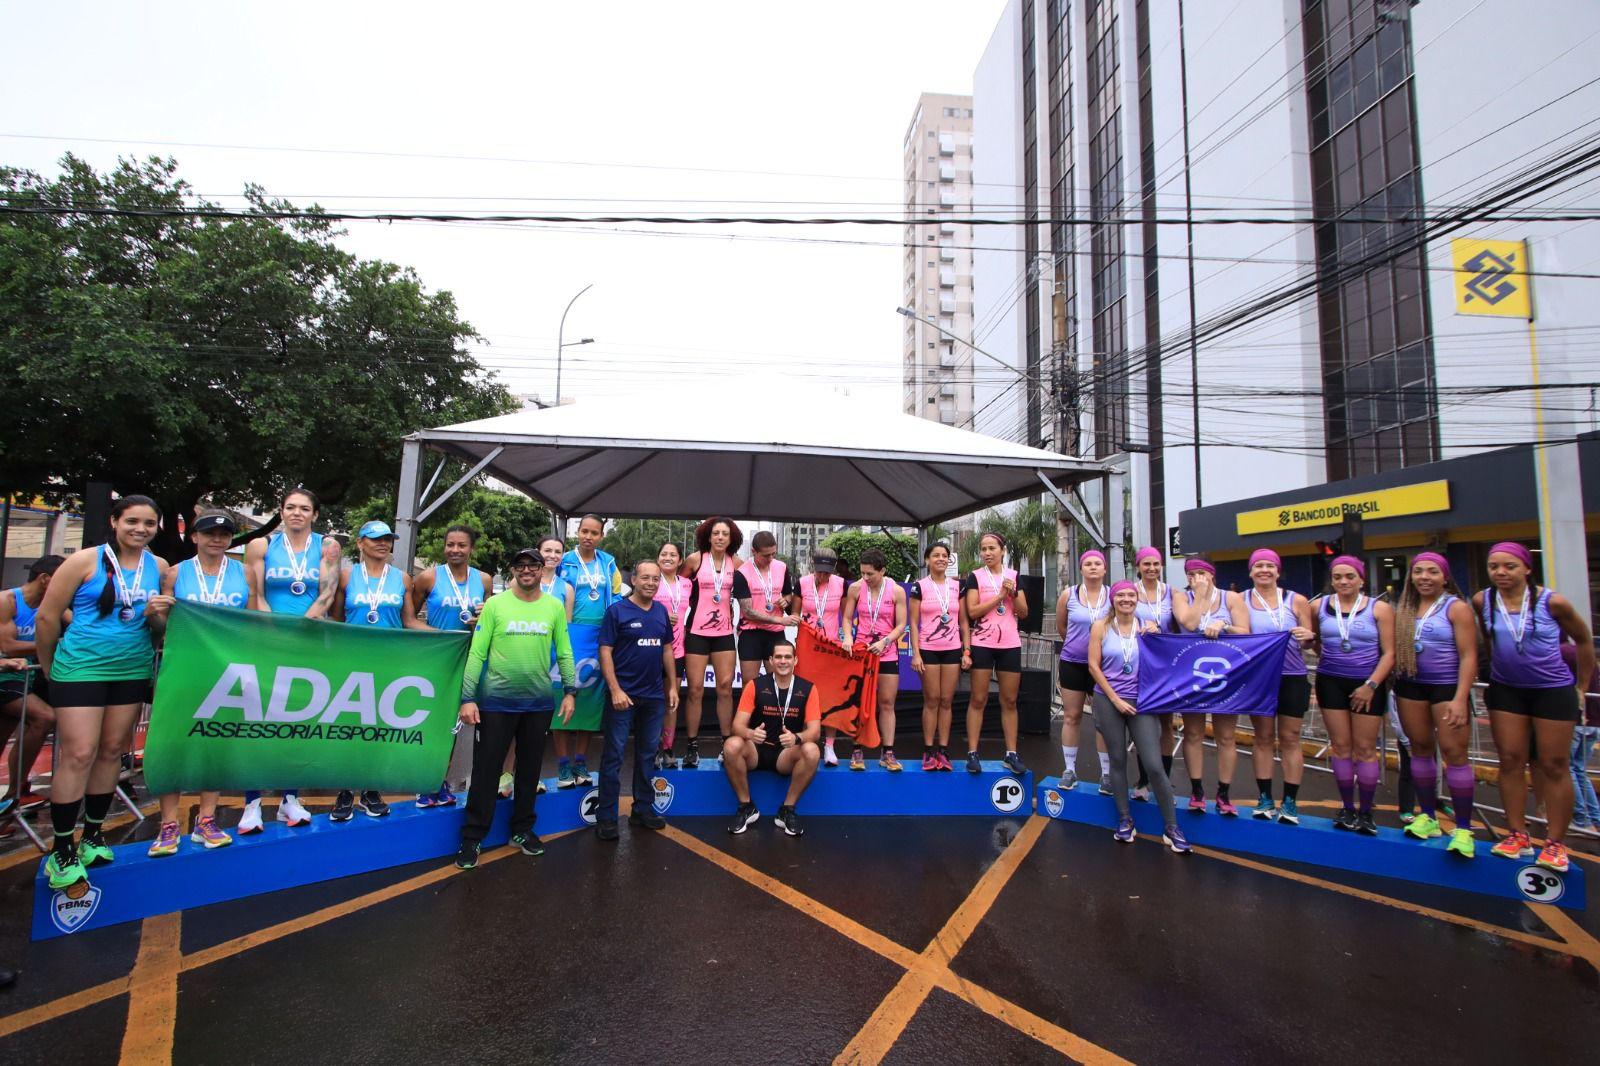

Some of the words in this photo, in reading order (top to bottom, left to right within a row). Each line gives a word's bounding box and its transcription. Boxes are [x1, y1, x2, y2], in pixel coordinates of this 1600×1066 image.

[1292, 508, 1326, 523] BANCO
[1326, 505, 1341, 518] DO
[1341, 501, 1380, 514] BRASIL
[505, 620, 548, 634] ADAC
[637, 638, 661, 647] CAIXA
[192, 662, 435, 729] ADAC
[188, 720, 323, 740] ASSESSORIA
[325, 725, 424, 746] ESPORTIVA
[57, 900, 93, 912] FBMS
